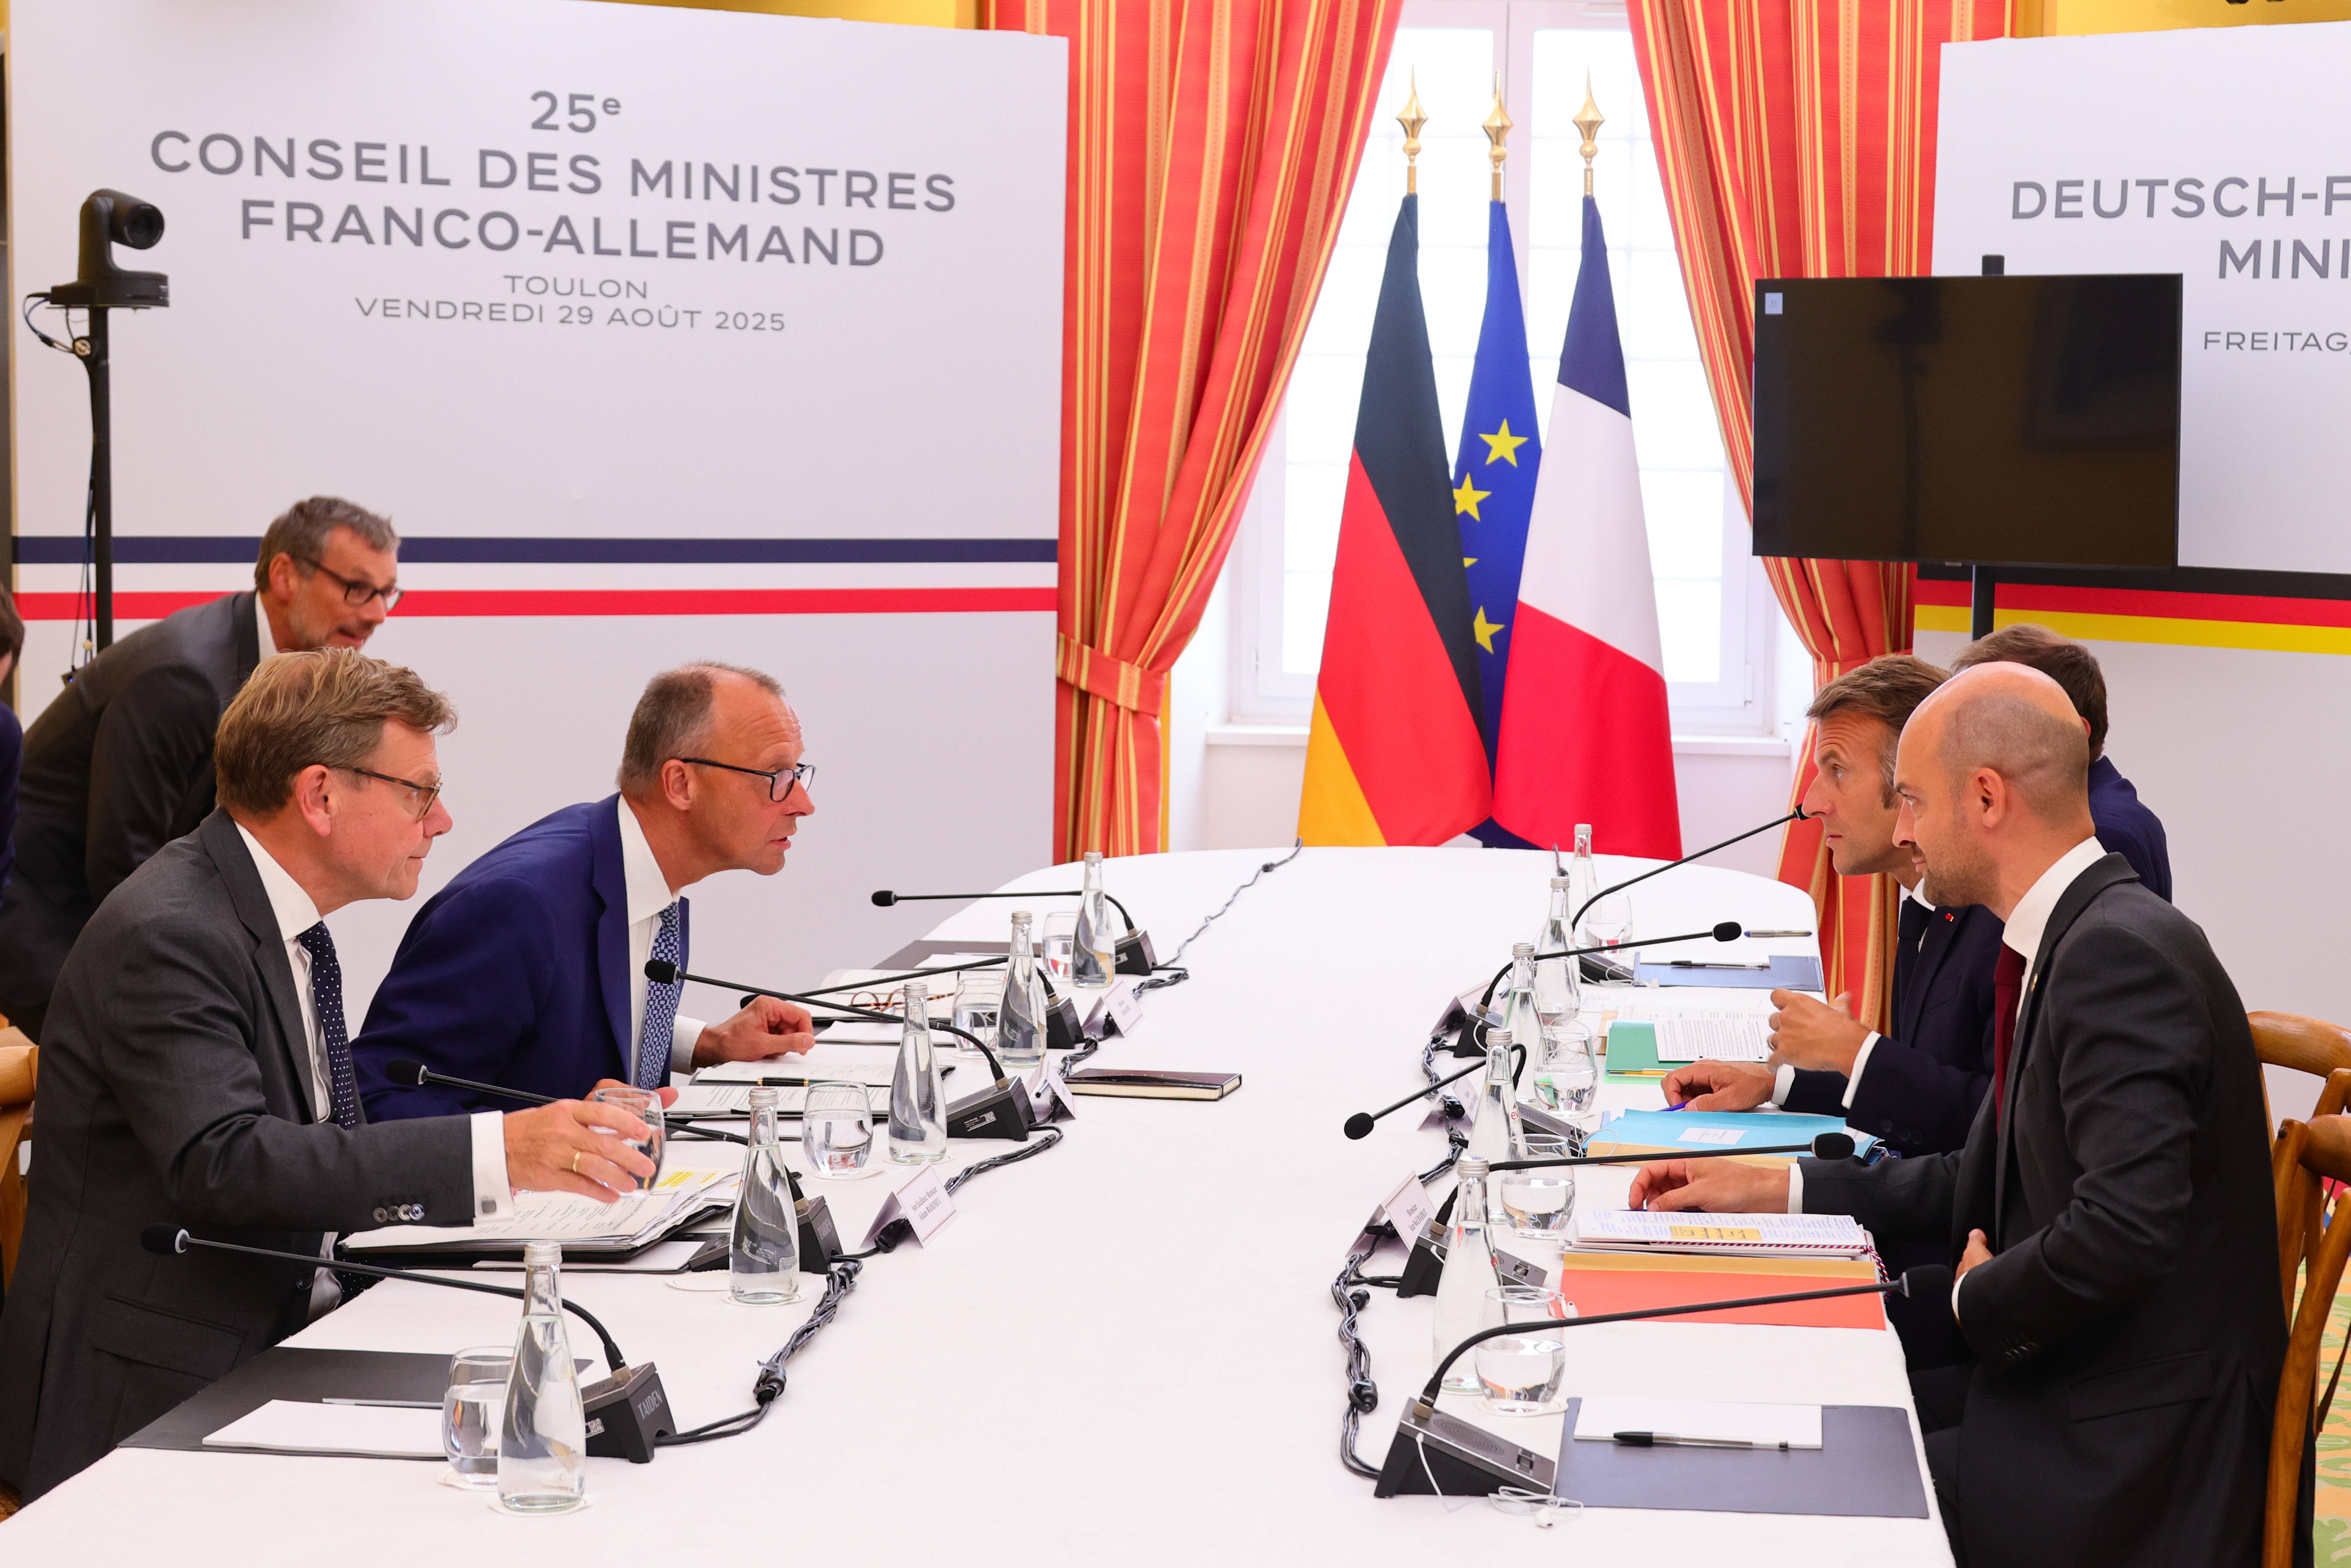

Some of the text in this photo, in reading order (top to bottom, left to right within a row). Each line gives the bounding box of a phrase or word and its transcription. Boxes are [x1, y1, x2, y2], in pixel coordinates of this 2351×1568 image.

[150, 130, 956, 213] CONSEIL DES MINISTRES
[2012, 175, 2351, 220] DEUTSCH-F
[241, 198, 885, 267] FRANCO-ALLEMAND
[2219, 238, 2351, 279] MINI
[503, 275, 647, 300] TOULON
[355, 297, 785, 332] VENDREDI 29 AOÛT 2025
[637, 1387, 662, 1420] TAIDEN
